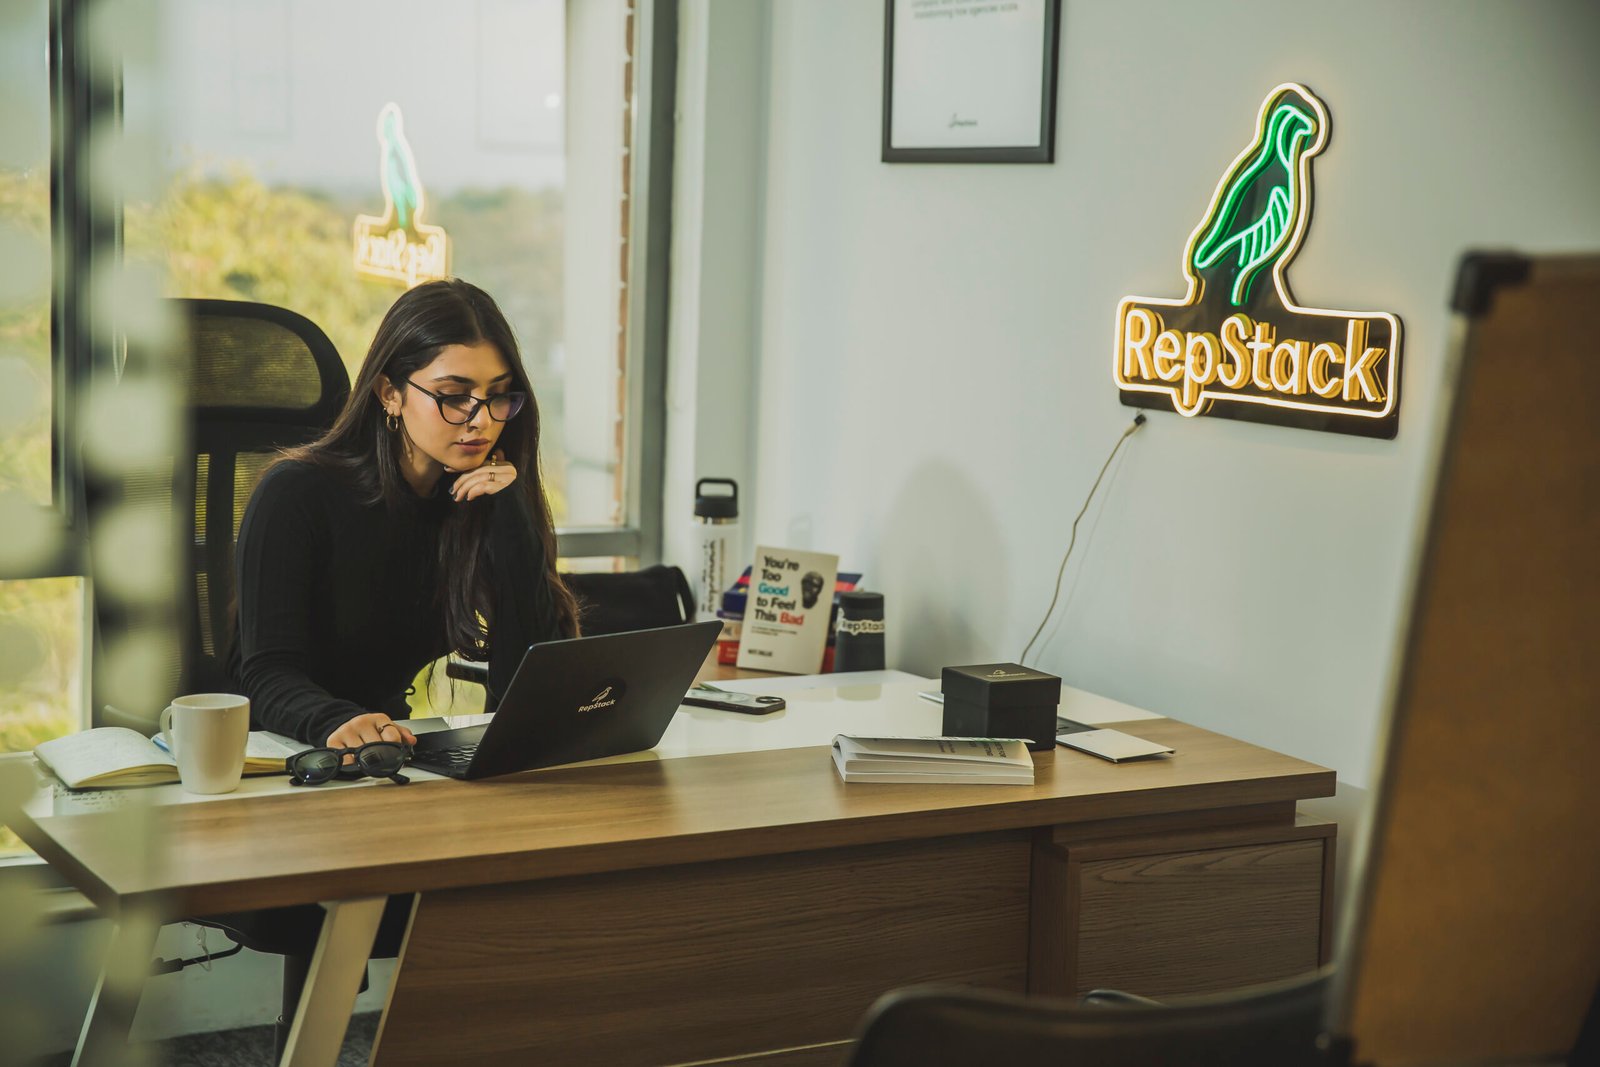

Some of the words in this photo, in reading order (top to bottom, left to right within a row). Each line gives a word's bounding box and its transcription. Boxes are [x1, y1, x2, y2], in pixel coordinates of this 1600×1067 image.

[1123, 308, 1384, 408] RepStack
[764, 556, 799, 571] You're
[761, 569, 782, 582] Too
[758, 582, 789, 597] Good
[756, 597, 768, 607] to
[770, 597, 796, 611] Feel
[755, 609, 777, 622] This
[780, 612, 804, 626] Bad
[578, 699, 616, 712] RepStack
